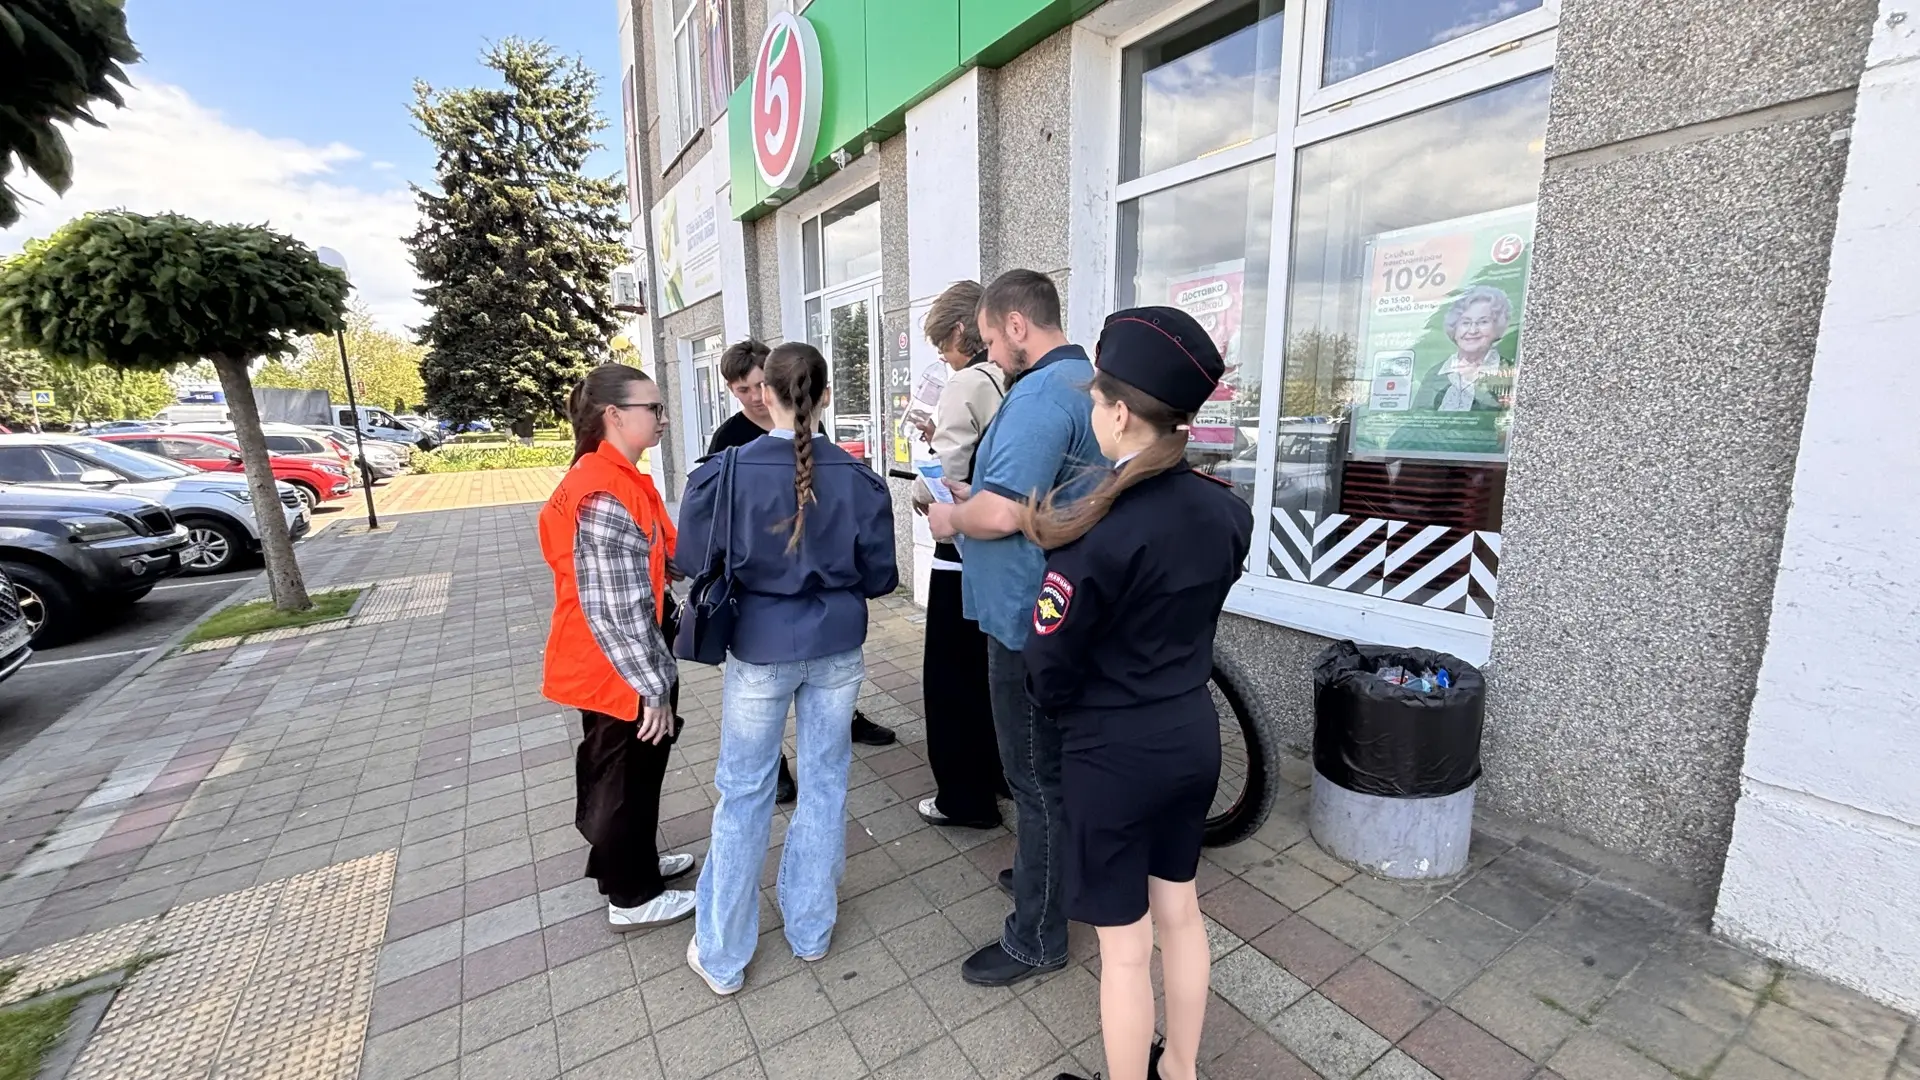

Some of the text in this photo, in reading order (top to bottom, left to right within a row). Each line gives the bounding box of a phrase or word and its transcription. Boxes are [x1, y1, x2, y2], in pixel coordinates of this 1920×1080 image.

[764, 24, 790, 156] 5
[1382, 262, 1446, 292] 10%
[1181, 284, 1224, 303] Доставка
[892, 367, 910, 387] 8-2
